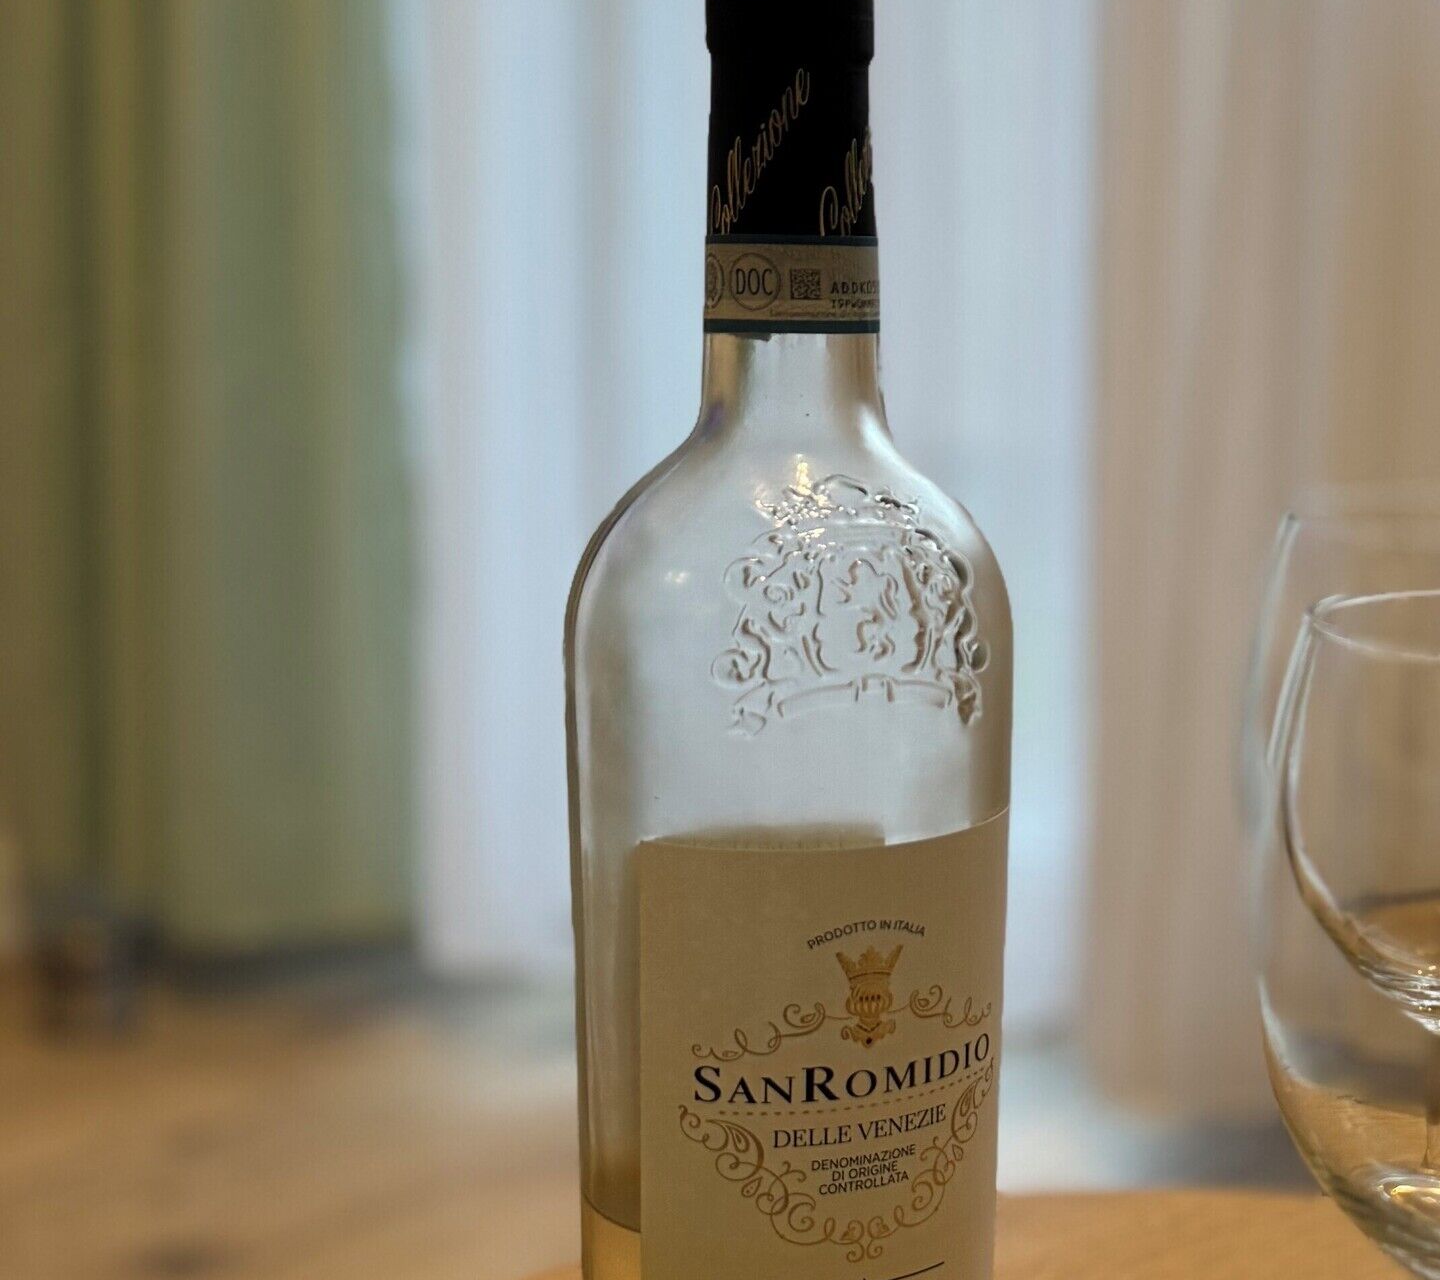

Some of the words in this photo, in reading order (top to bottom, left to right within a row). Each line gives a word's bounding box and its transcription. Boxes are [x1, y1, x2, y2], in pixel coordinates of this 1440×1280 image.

[735, 267, 773, 296] DOC
[807, 920, 877, 949] PRODOTTO
[880, 920, 892, 930] IN
[893, 920, 926, 937] ITALIA
[772, 1123, 852, 1149] DELLE
[857, 1103, 946, 1142] VENEZIE
[811, 1144, 917, 1172] DENOMINAZIONE
[832, 1170, 845, 1182] DI
[848, 1160, 899, 1180] ORIGINE
[818, 1170, 909, 1196] CONTROLLATA
